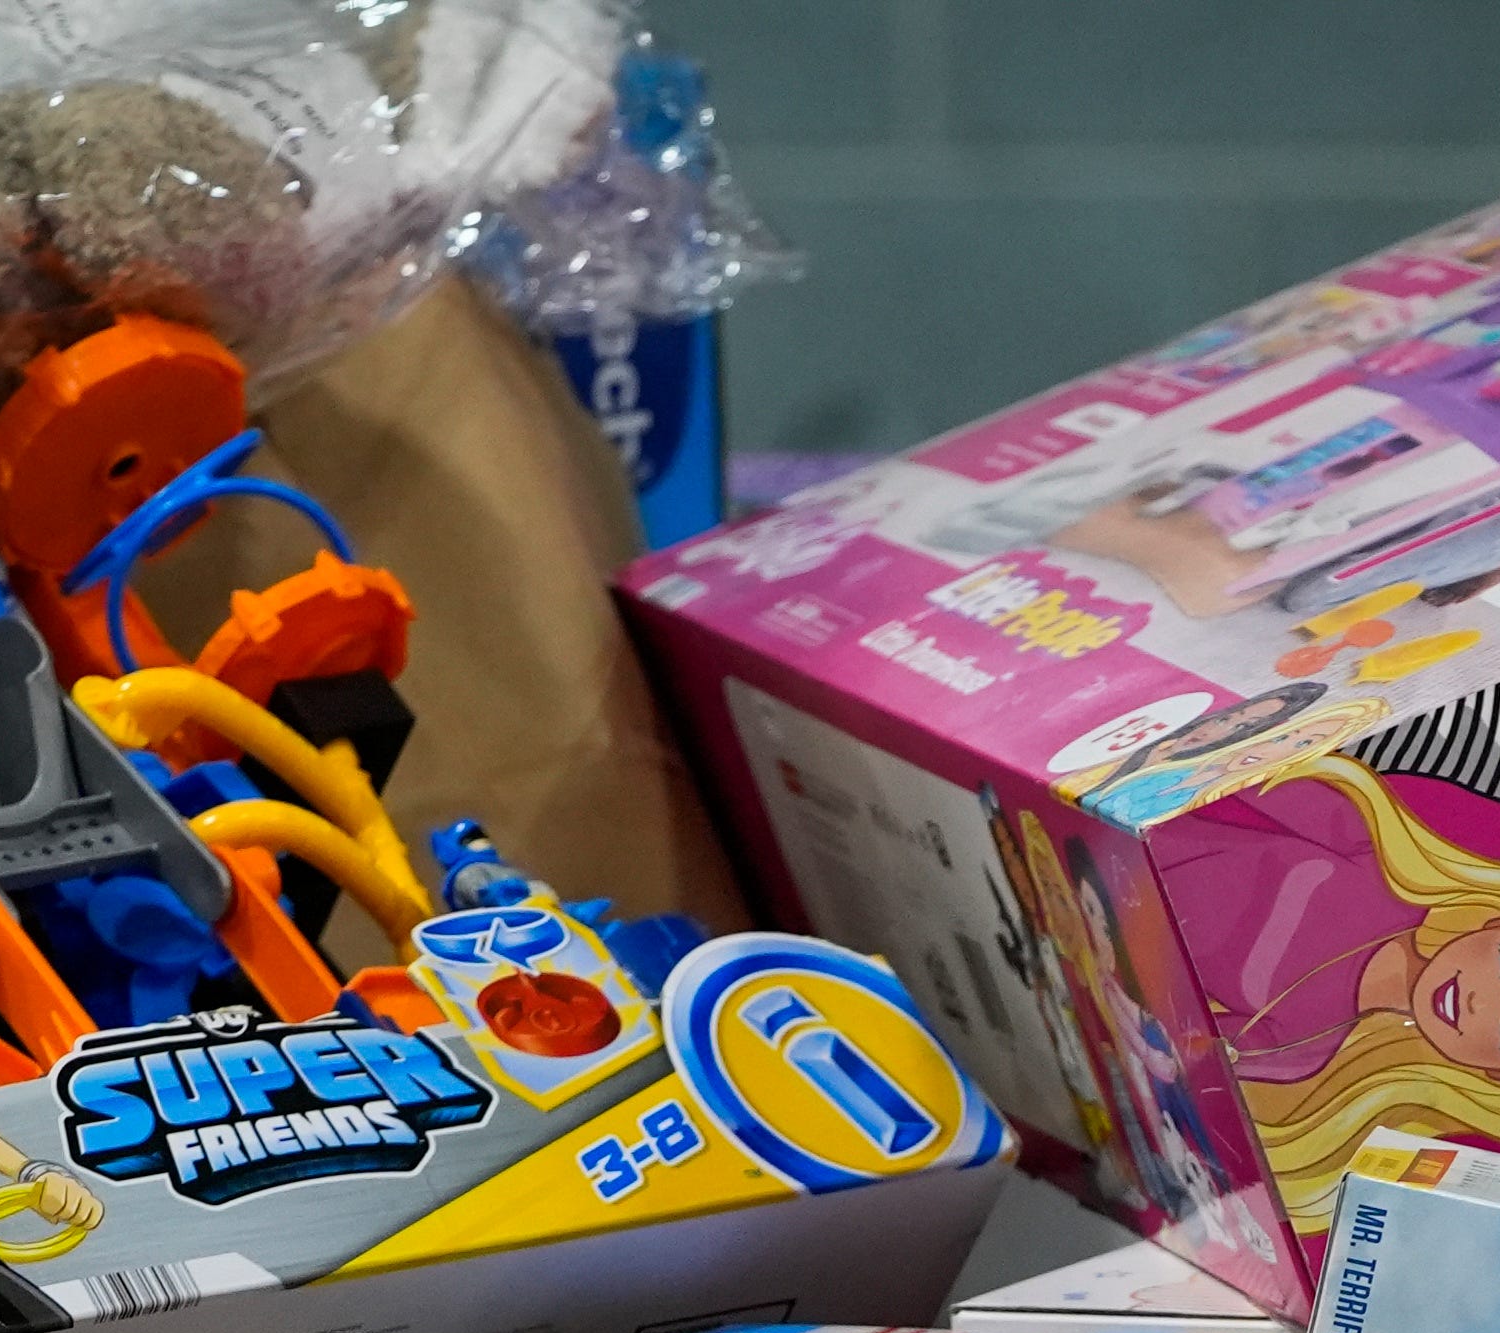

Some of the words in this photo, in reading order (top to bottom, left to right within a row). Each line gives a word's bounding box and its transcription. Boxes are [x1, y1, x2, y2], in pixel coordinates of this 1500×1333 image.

[67, 1029, 479, 1157] SUPER
[165, 1100, 419, 1186] FRIENDS
[578, 1104, 701, 1202] 3-8
[1349, 1204, 1388, 1246] MR.
